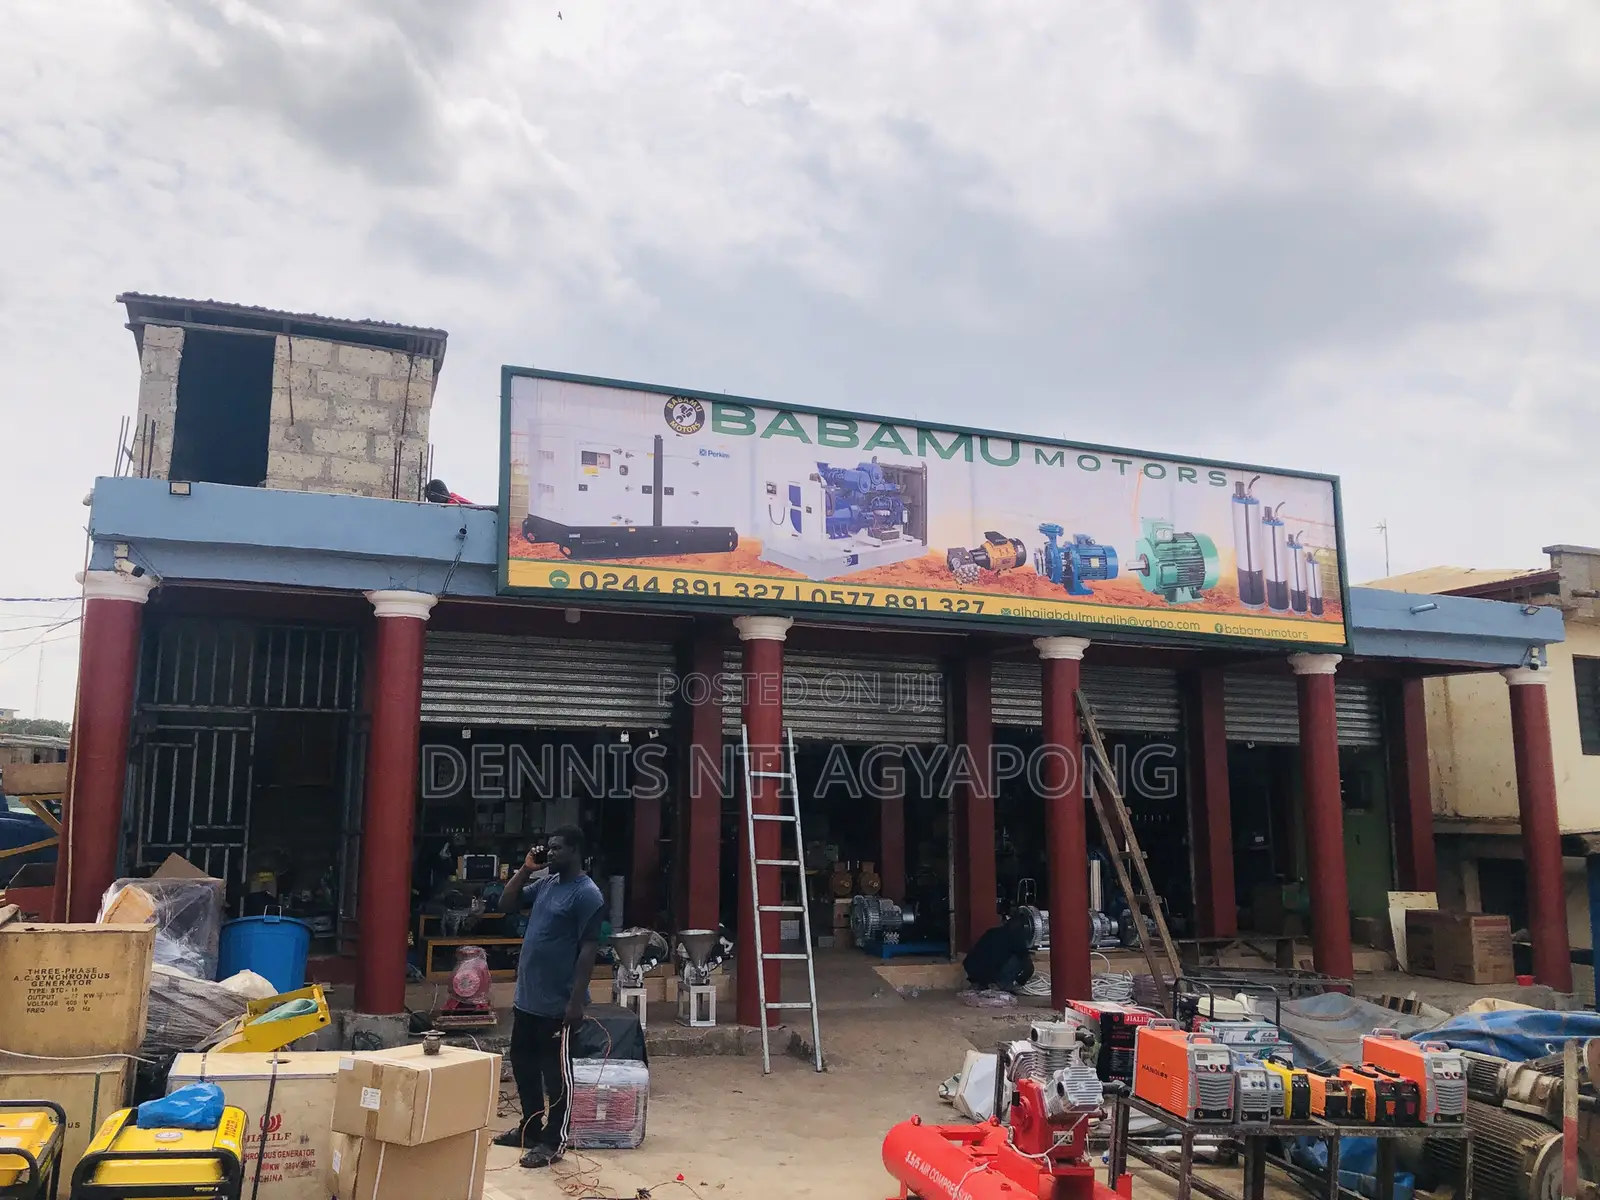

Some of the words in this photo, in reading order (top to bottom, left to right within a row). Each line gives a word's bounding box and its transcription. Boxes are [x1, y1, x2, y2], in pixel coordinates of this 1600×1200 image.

[667, 397, 702, 412] BABAMU
[670, 421, 700, 433] MOTORS
[711, 402, 1020, 466] BABAMU
[1034, 448, 1227, 487] MOTORS
[580, 571, 660, 593] 0244
[672, 578, 721, 597] 891
[734, 583, 785, 600] 327
[811, 588, 875, 607] 0577
[885, 594, 928, 611] 891
[940, 598, 985, 615] 327
[1225, 623, 1308, 639] babamumotors
[28, 967, 98, 975] THREE-PHASE
[31, 979, 92, 987] GENERATOR
[277, 1149, 315, 1159] GENERATOR
[919, 1160, 931, 1177] AIR
